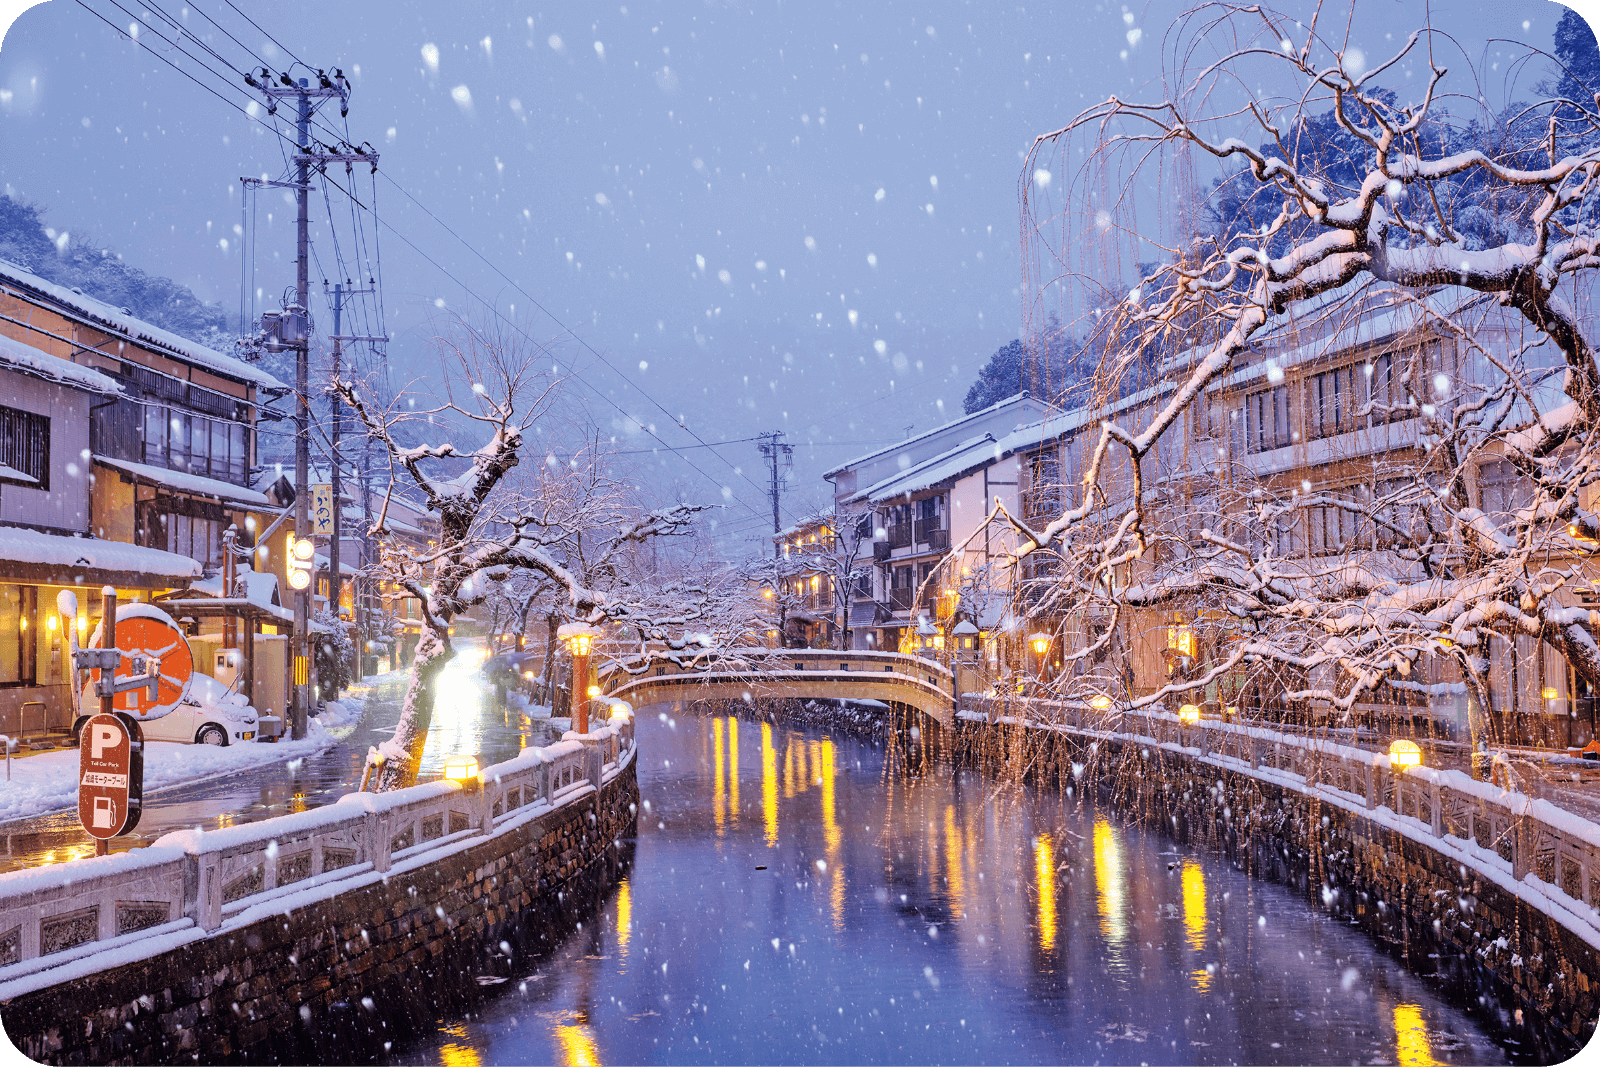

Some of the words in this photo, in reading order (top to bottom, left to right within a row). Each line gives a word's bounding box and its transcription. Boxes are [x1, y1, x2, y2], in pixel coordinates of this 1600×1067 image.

[316, 496, 331, 530] かめや
[92, 724, 122, 758] P
